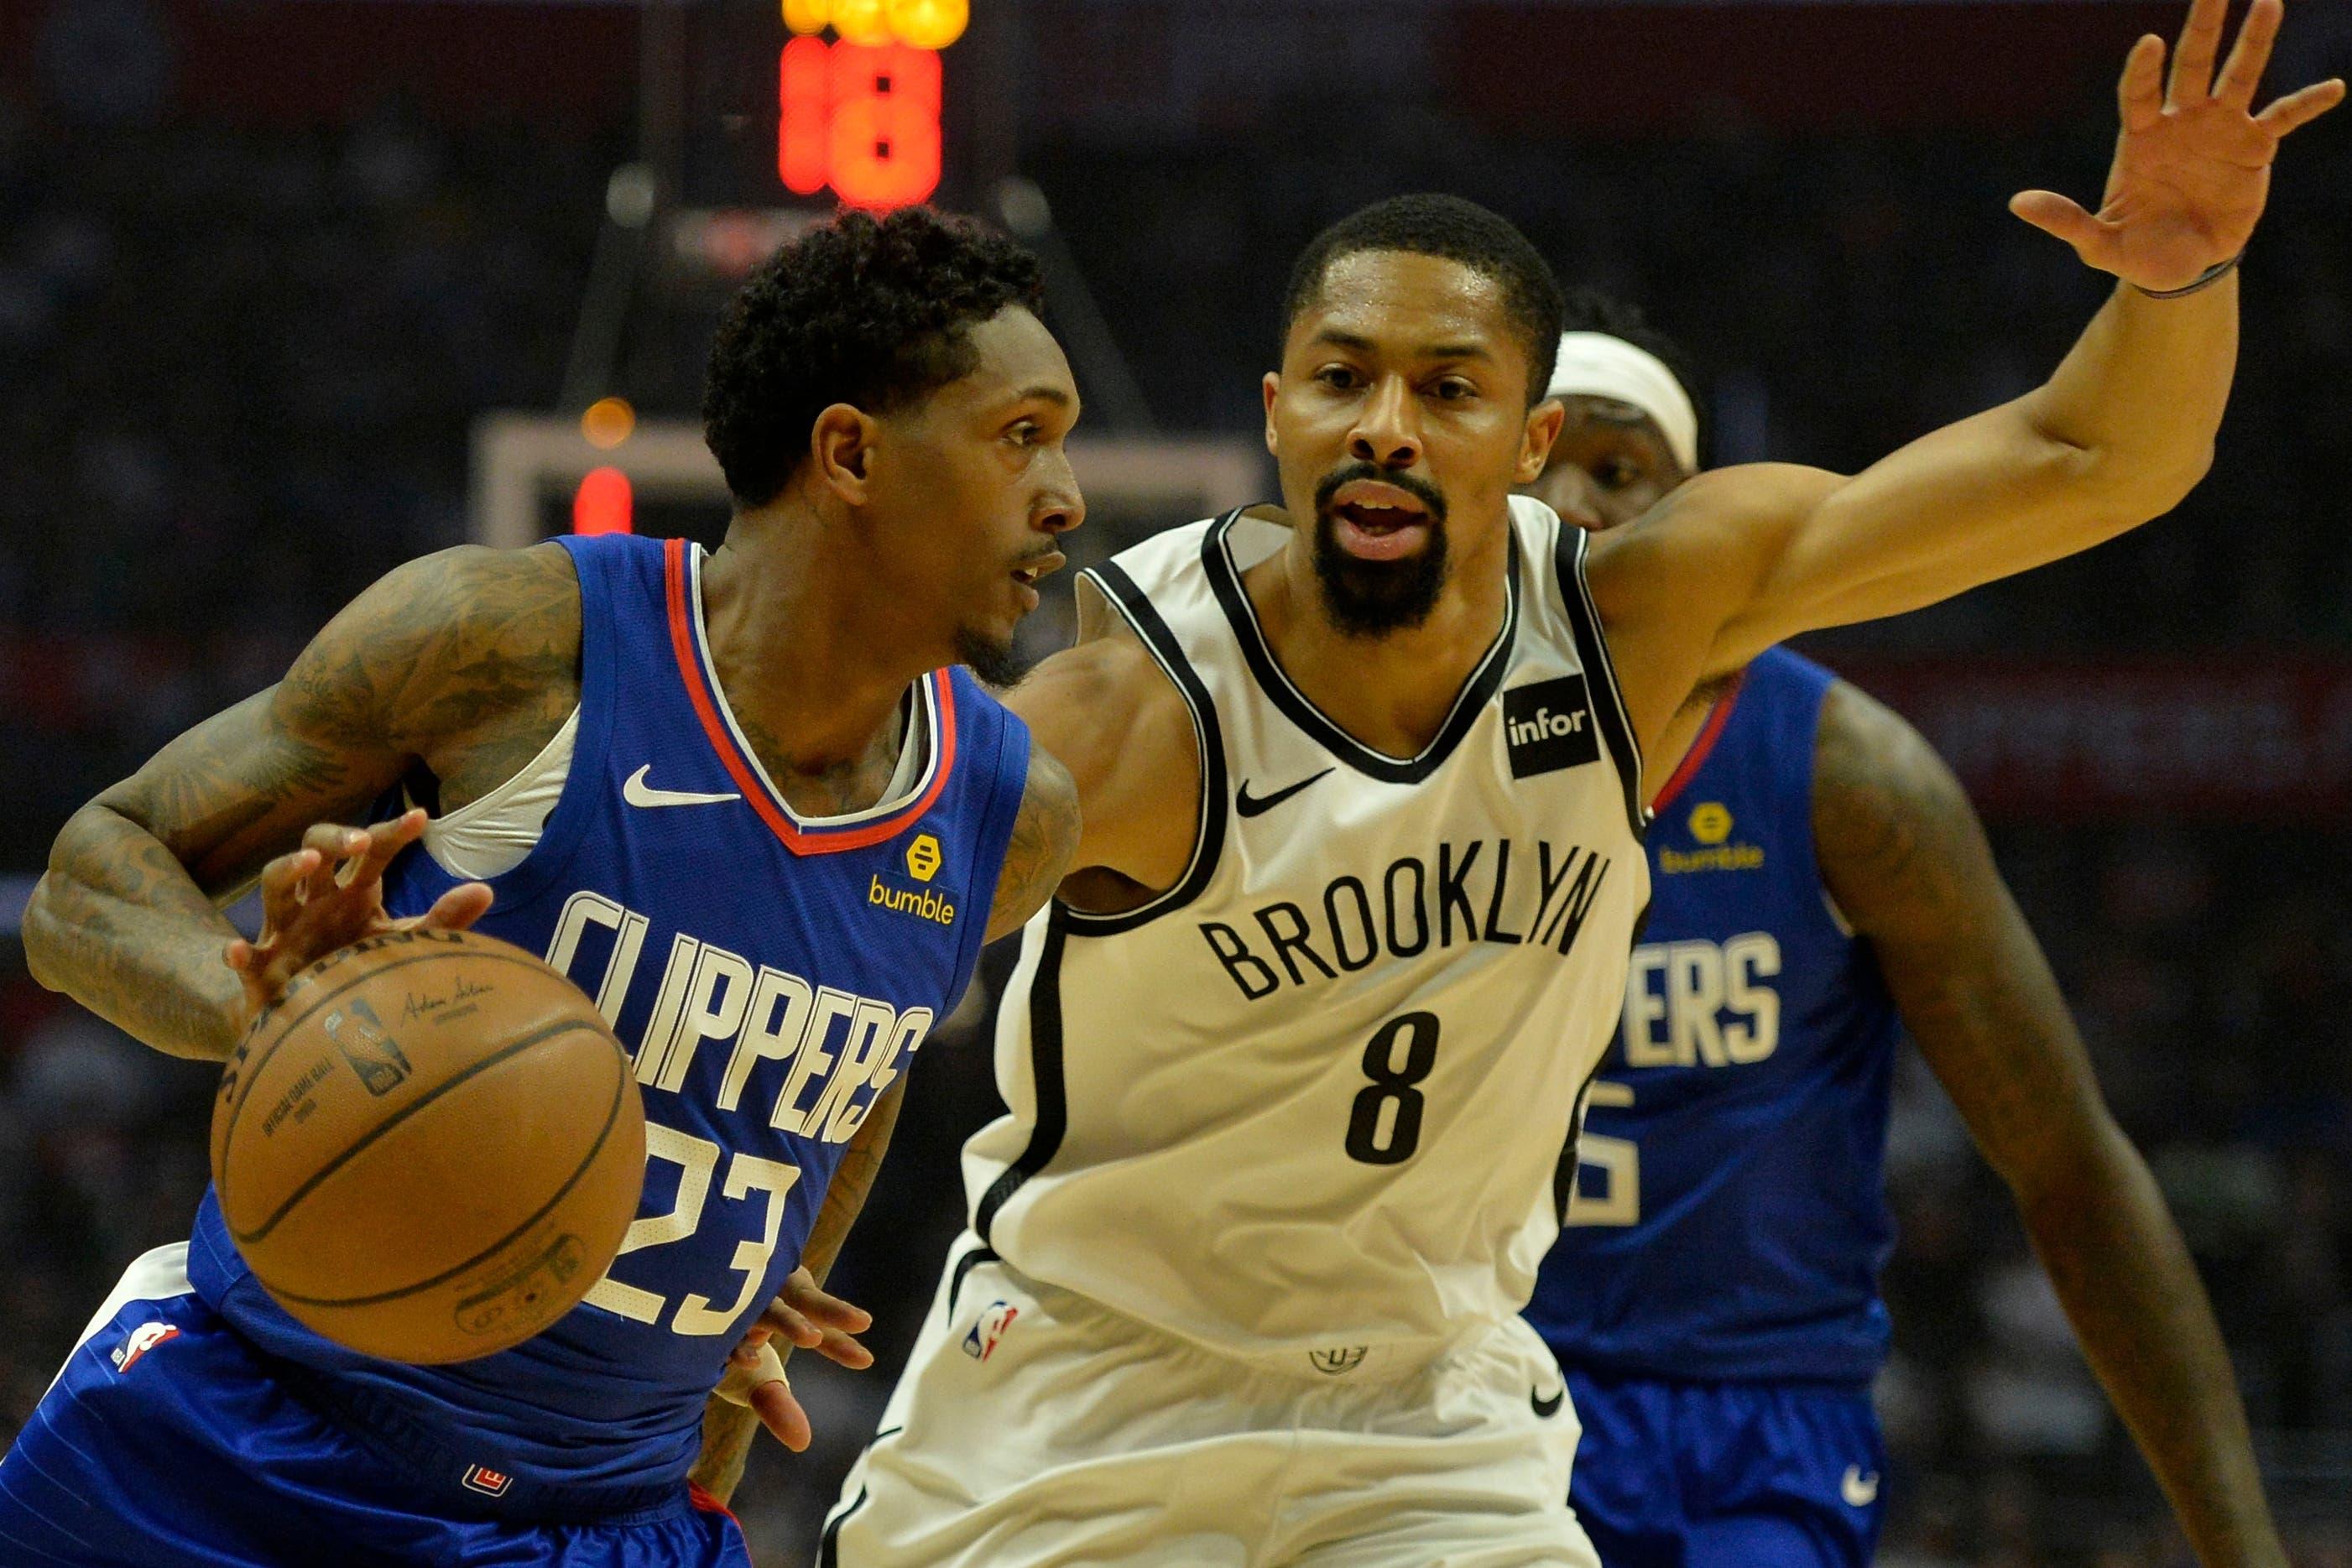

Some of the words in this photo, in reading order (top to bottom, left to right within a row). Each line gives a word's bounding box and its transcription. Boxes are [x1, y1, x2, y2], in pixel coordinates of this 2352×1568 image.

[1508, 707, 1586, 747] infor
[868, 873, 955, 925] bumble
[1660, 845, 1765, 874] bumble
[1200, 839, 1610, 1001] BROOKLYN
[1345, 1010, 1441, 1164] 8
[582, 1120, 801, 1336] 23
